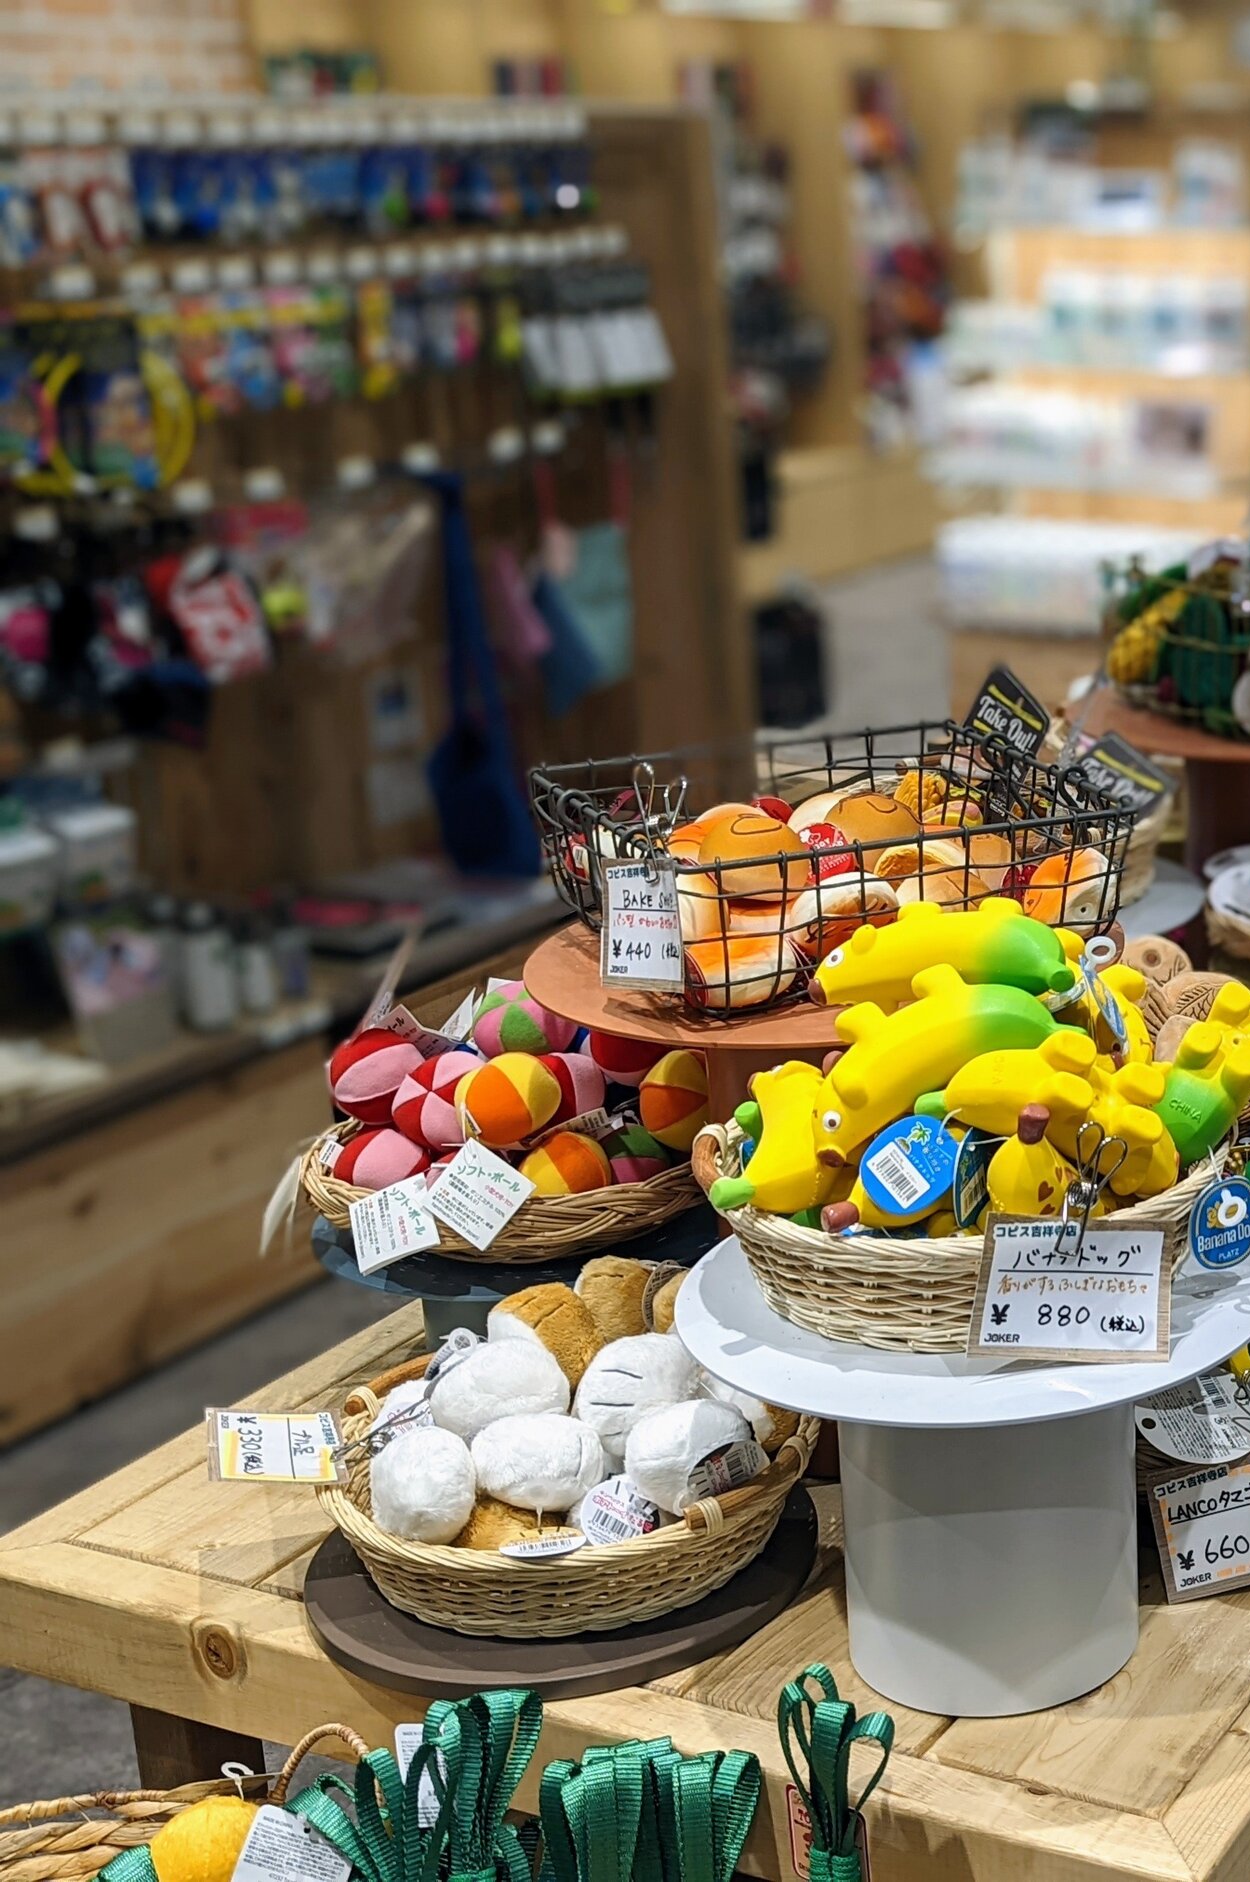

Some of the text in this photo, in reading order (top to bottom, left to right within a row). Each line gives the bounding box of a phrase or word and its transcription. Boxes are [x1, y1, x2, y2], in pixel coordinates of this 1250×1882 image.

[977, 696, 1038, 755] Take Out!
[622, 889, 653, 909] BAKE
[612, 939, 622, 959] ¥
[626, 942, 651, 960] 440
[610, 965, 628, 974] JOKER
[1169, 1099, 1202, 1122] CHINA
[457, 1165, 521, 1193] ソフト・ボール
[389, 1188, 426, 1236] ソフト・ボール
[1197, 1229, 1237, 1253] Banana
[1218, 1247, 1240, 1260] PLATZ
[991, 1304, 1146, 1335] ¥ 880 (税込)
[984, 1333, 1020, 1343] JOKER
[221, 1414, 230, 1429] JOKER
[236, 1416, 257, 1425] ¥
[238, 1428, 263, 1451] 330
[1156, 1467, 1228, 1498] コピス吉祥寺店
[1177, 1550, 1195, 1571] ¥
[1205, 1535, 1250, 1564] 660
[1180, 1572, 1212, 1588] JOKER
